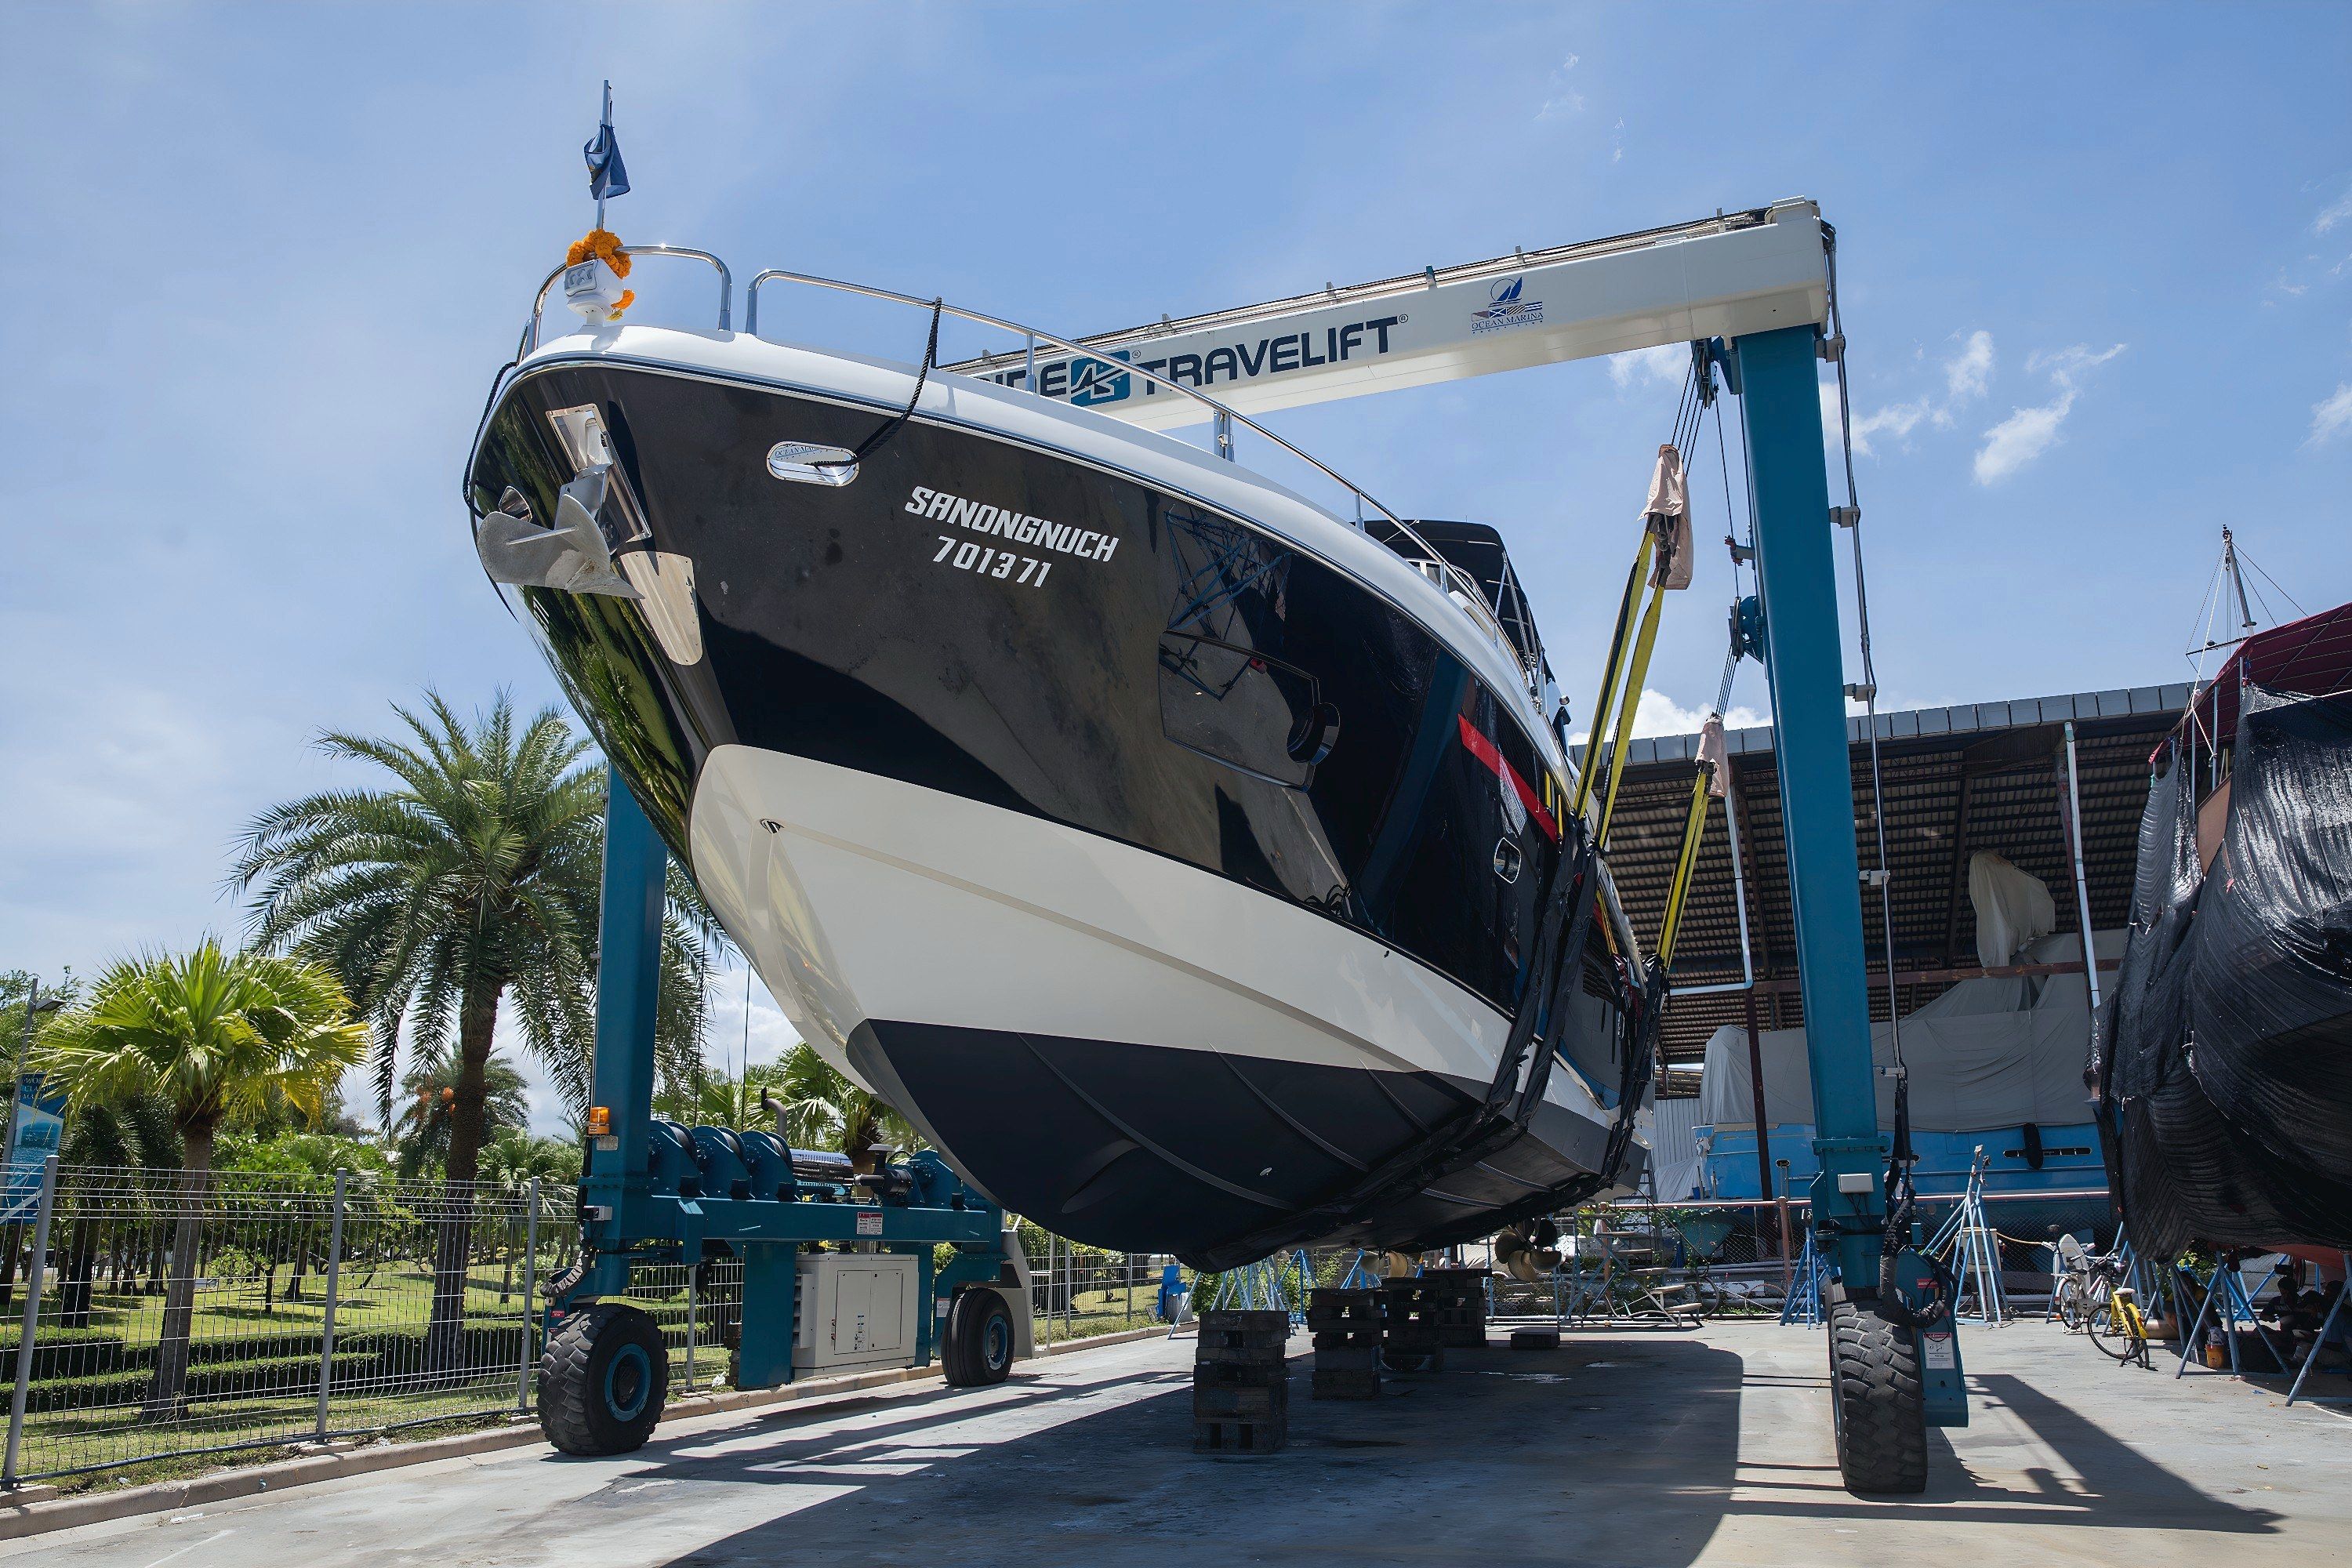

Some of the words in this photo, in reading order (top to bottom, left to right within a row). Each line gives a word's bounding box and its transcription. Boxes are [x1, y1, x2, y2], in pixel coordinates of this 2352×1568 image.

[1472, 318, 1504, 329] OCEAN
[1506, 312, 1544, 323] MARINA
[905, 485, 1120, 562] SANONGNUCH
[933, 535, 1052, 587] 701371
